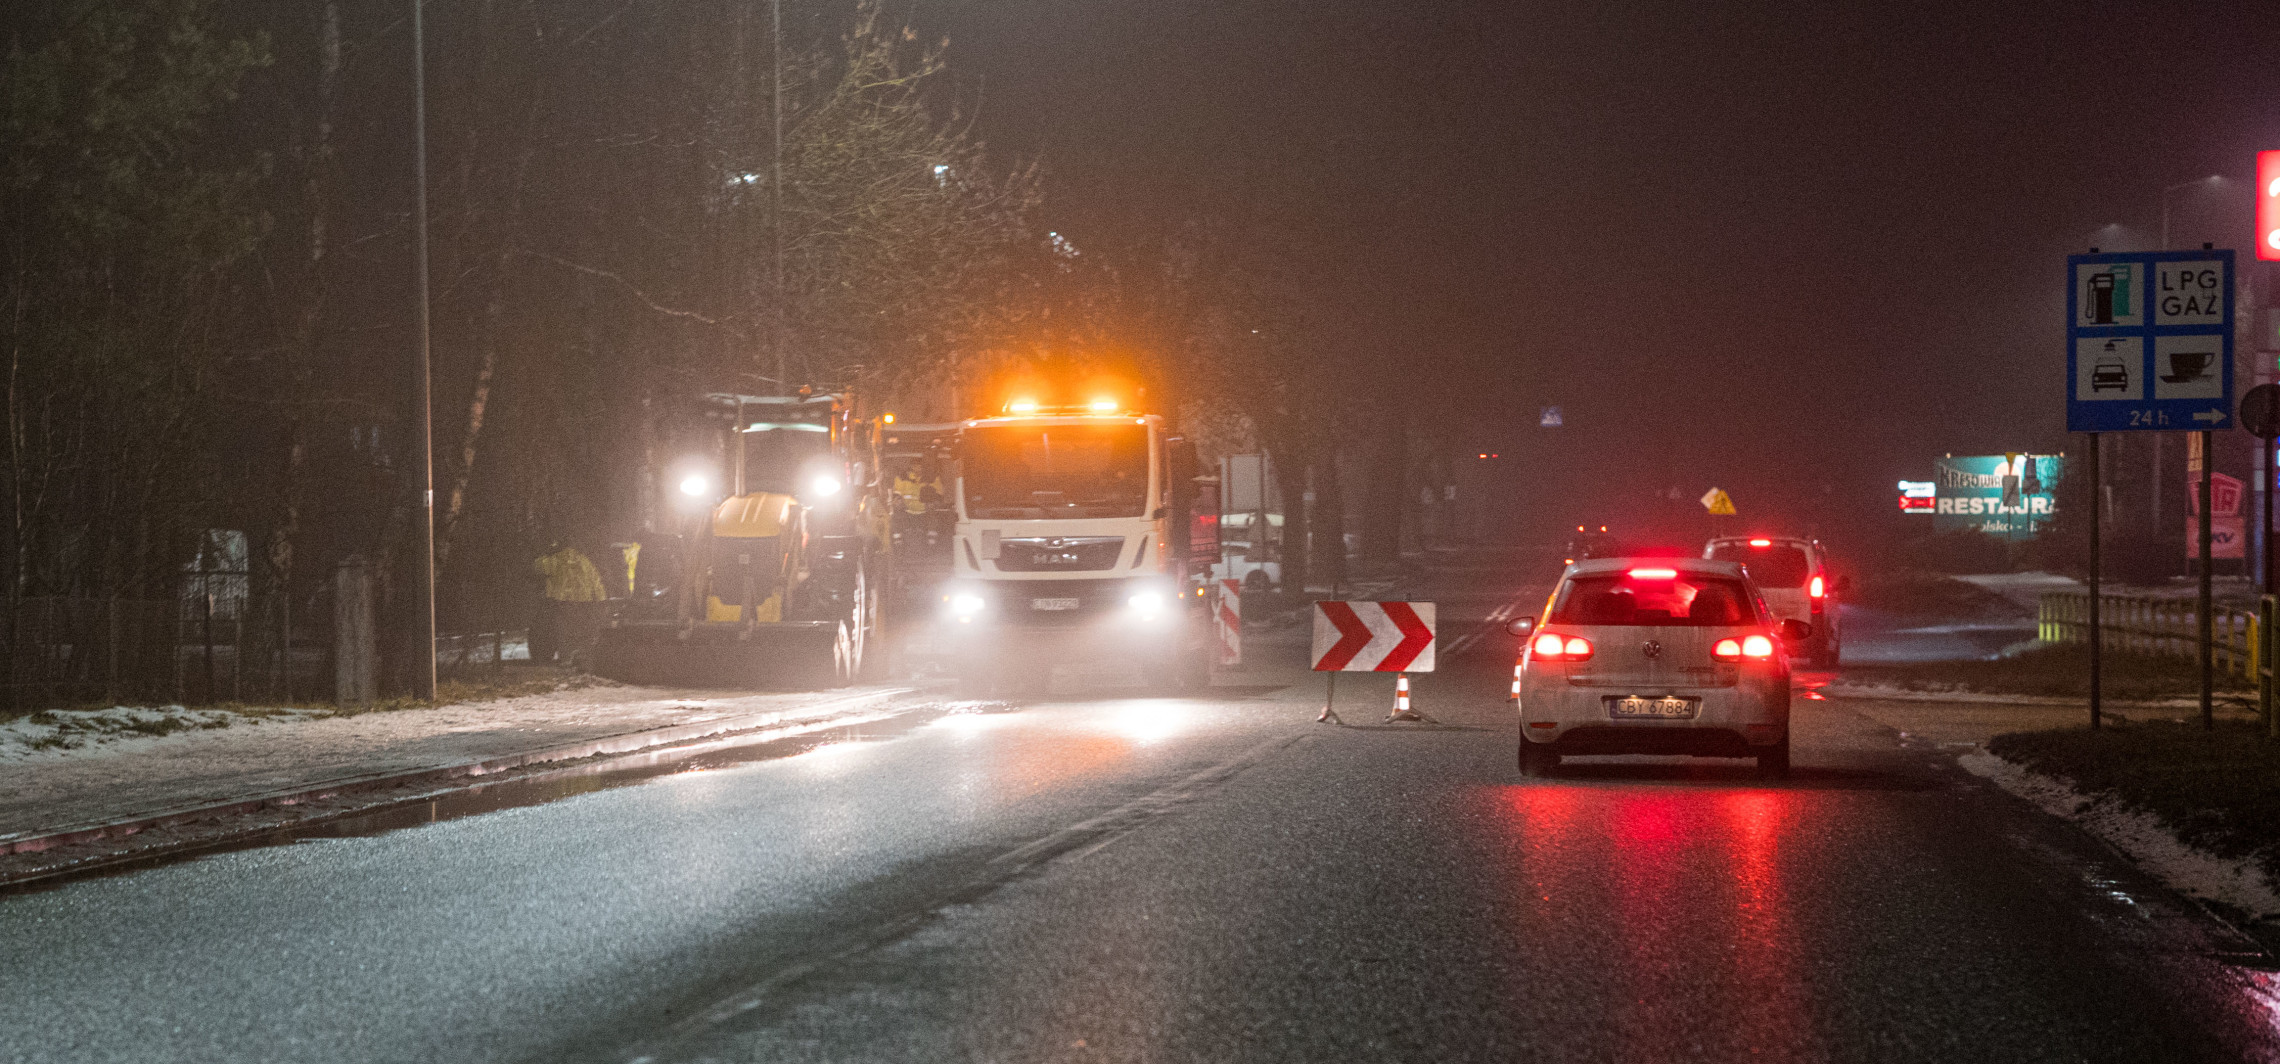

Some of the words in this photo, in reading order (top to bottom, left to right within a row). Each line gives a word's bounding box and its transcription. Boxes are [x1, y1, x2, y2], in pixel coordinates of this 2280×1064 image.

[2161, 269, 2217, 291] LPG
[2161, 295, 2217, 316] GAZ
[2129, 409, 2153, 426] 24
[2158, 409, 2170, 425] h
[1937, 497, 2058, 515] RESTAUR
[1617, 700, 1644, 714] CBY
[1649, 700, 1692, 715] 67884
